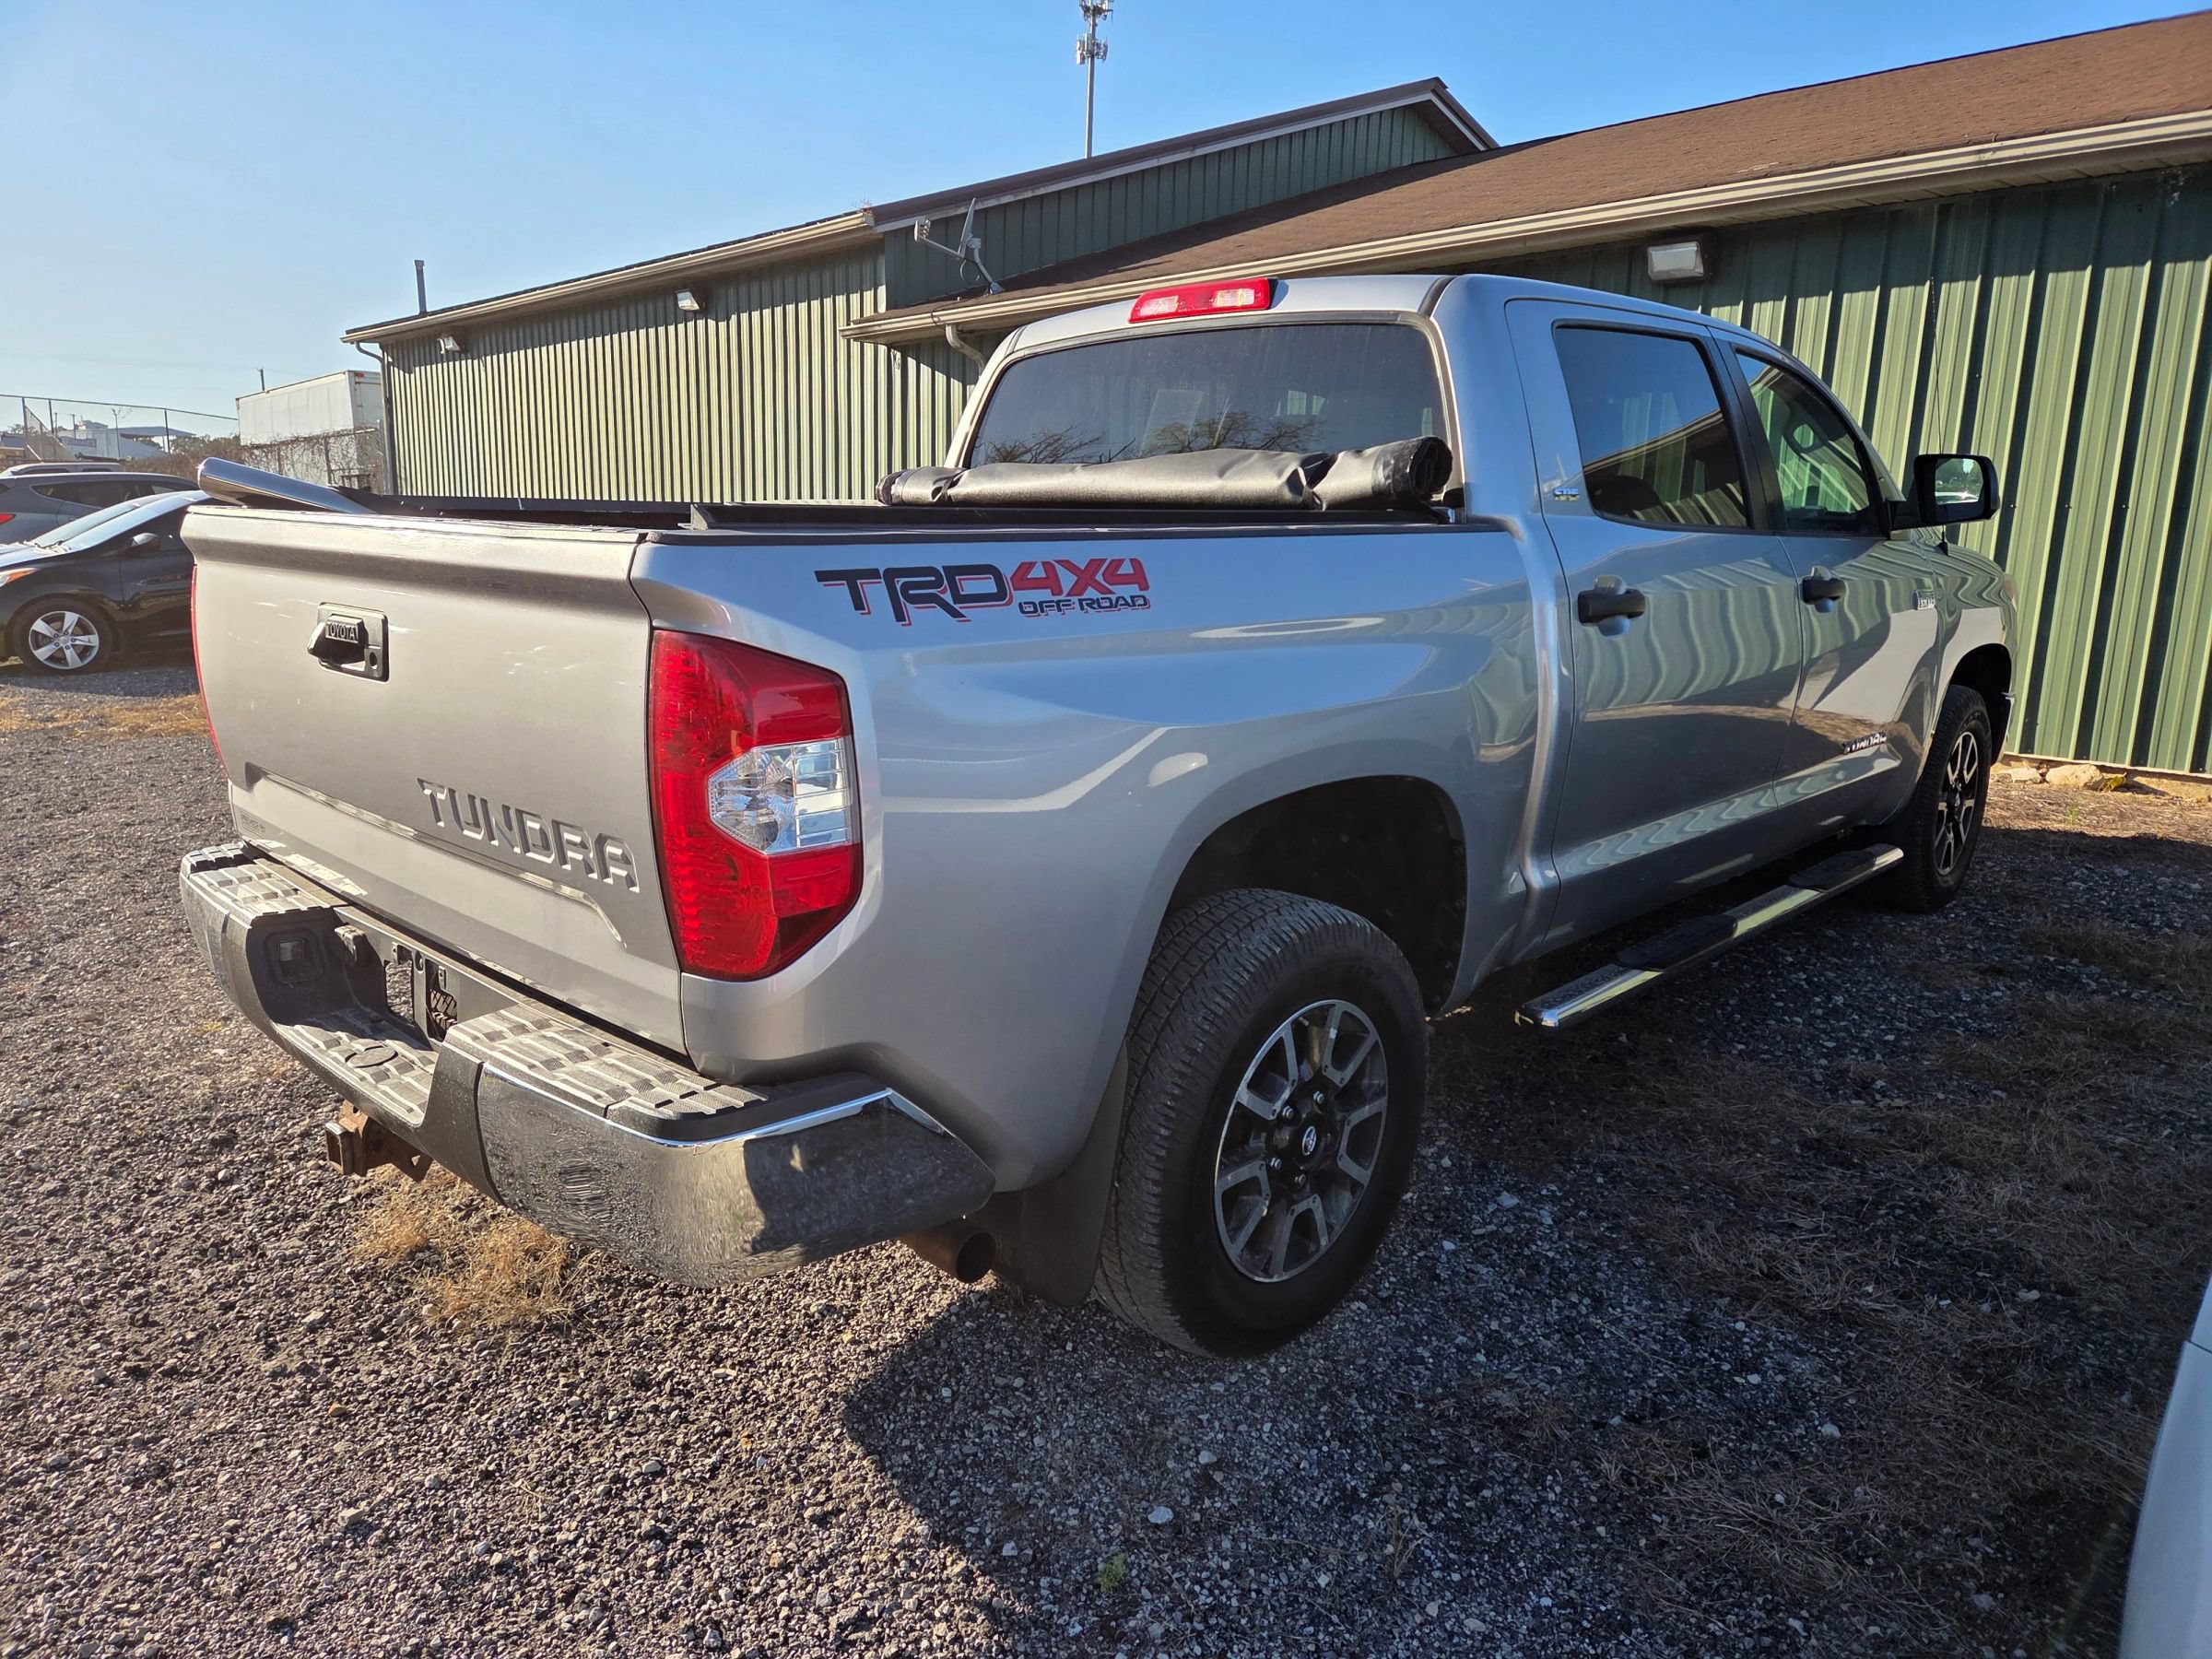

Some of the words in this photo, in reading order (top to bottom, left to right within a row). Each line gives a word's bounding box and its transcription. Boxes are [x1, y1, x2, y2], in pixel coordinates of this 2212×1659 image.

[814, 563, 1013, 626] TRD
[1008, 558, 1150, 596] 4X4
[1018, 598, 1075, 617] OFF
[1078, 594, 1151, 612] ROAD
[325, 621, 358, 641] TOYOTA
[416, 777, 640, 893] TUNDRA
